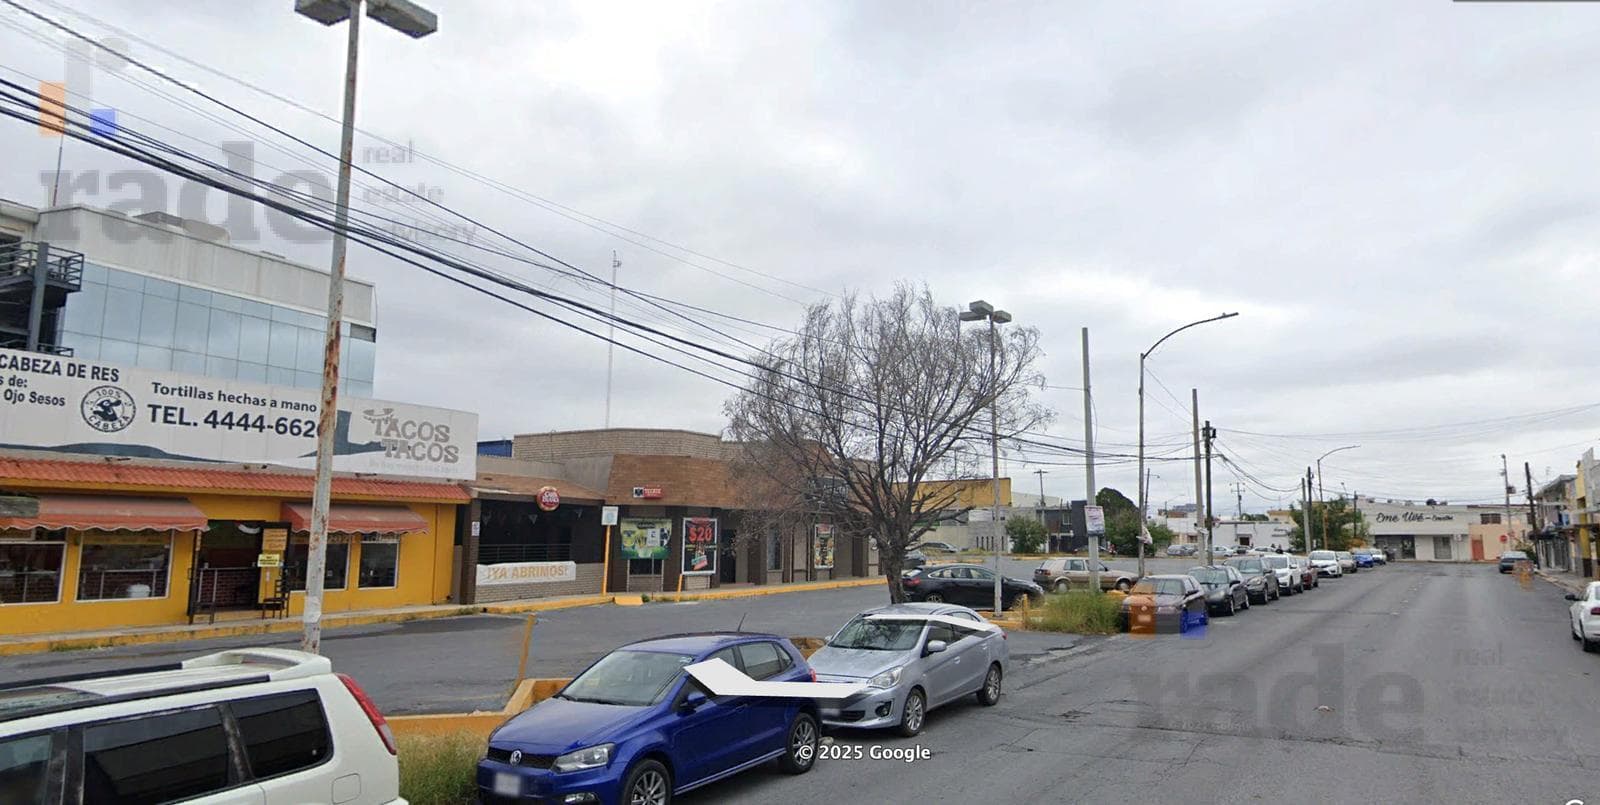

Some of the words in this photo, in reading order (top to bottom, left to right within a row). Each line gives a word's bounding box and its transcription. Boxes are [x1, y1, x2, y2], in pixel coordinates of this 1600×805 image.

[0, 354, 62, 376] CABEZA
[67, 363, 87, 379] DE
[91, 366, 120, 383] RES
[8, 375, 28, 388] de:
[3, 388, 25, 405] Ojo
[28, 391, 66, 407] Sesos
[96, 388, 122, 399] 100%
[151, 382, 214, 401] Tortillas
[217, 390, 267, 407] hechas
[269, 399, 278, 408] a
[280, 400, 317, 413] mano
[88, 414, 130, 431] CABEZA
[147, 404, 199, 427] TEL.
[203, 409, 321, 438] 4444-662
[374, 418, 451, 443] TACOS
[382, 438, 460, 464] TACOS
[688, 527, 713, 544] $20
